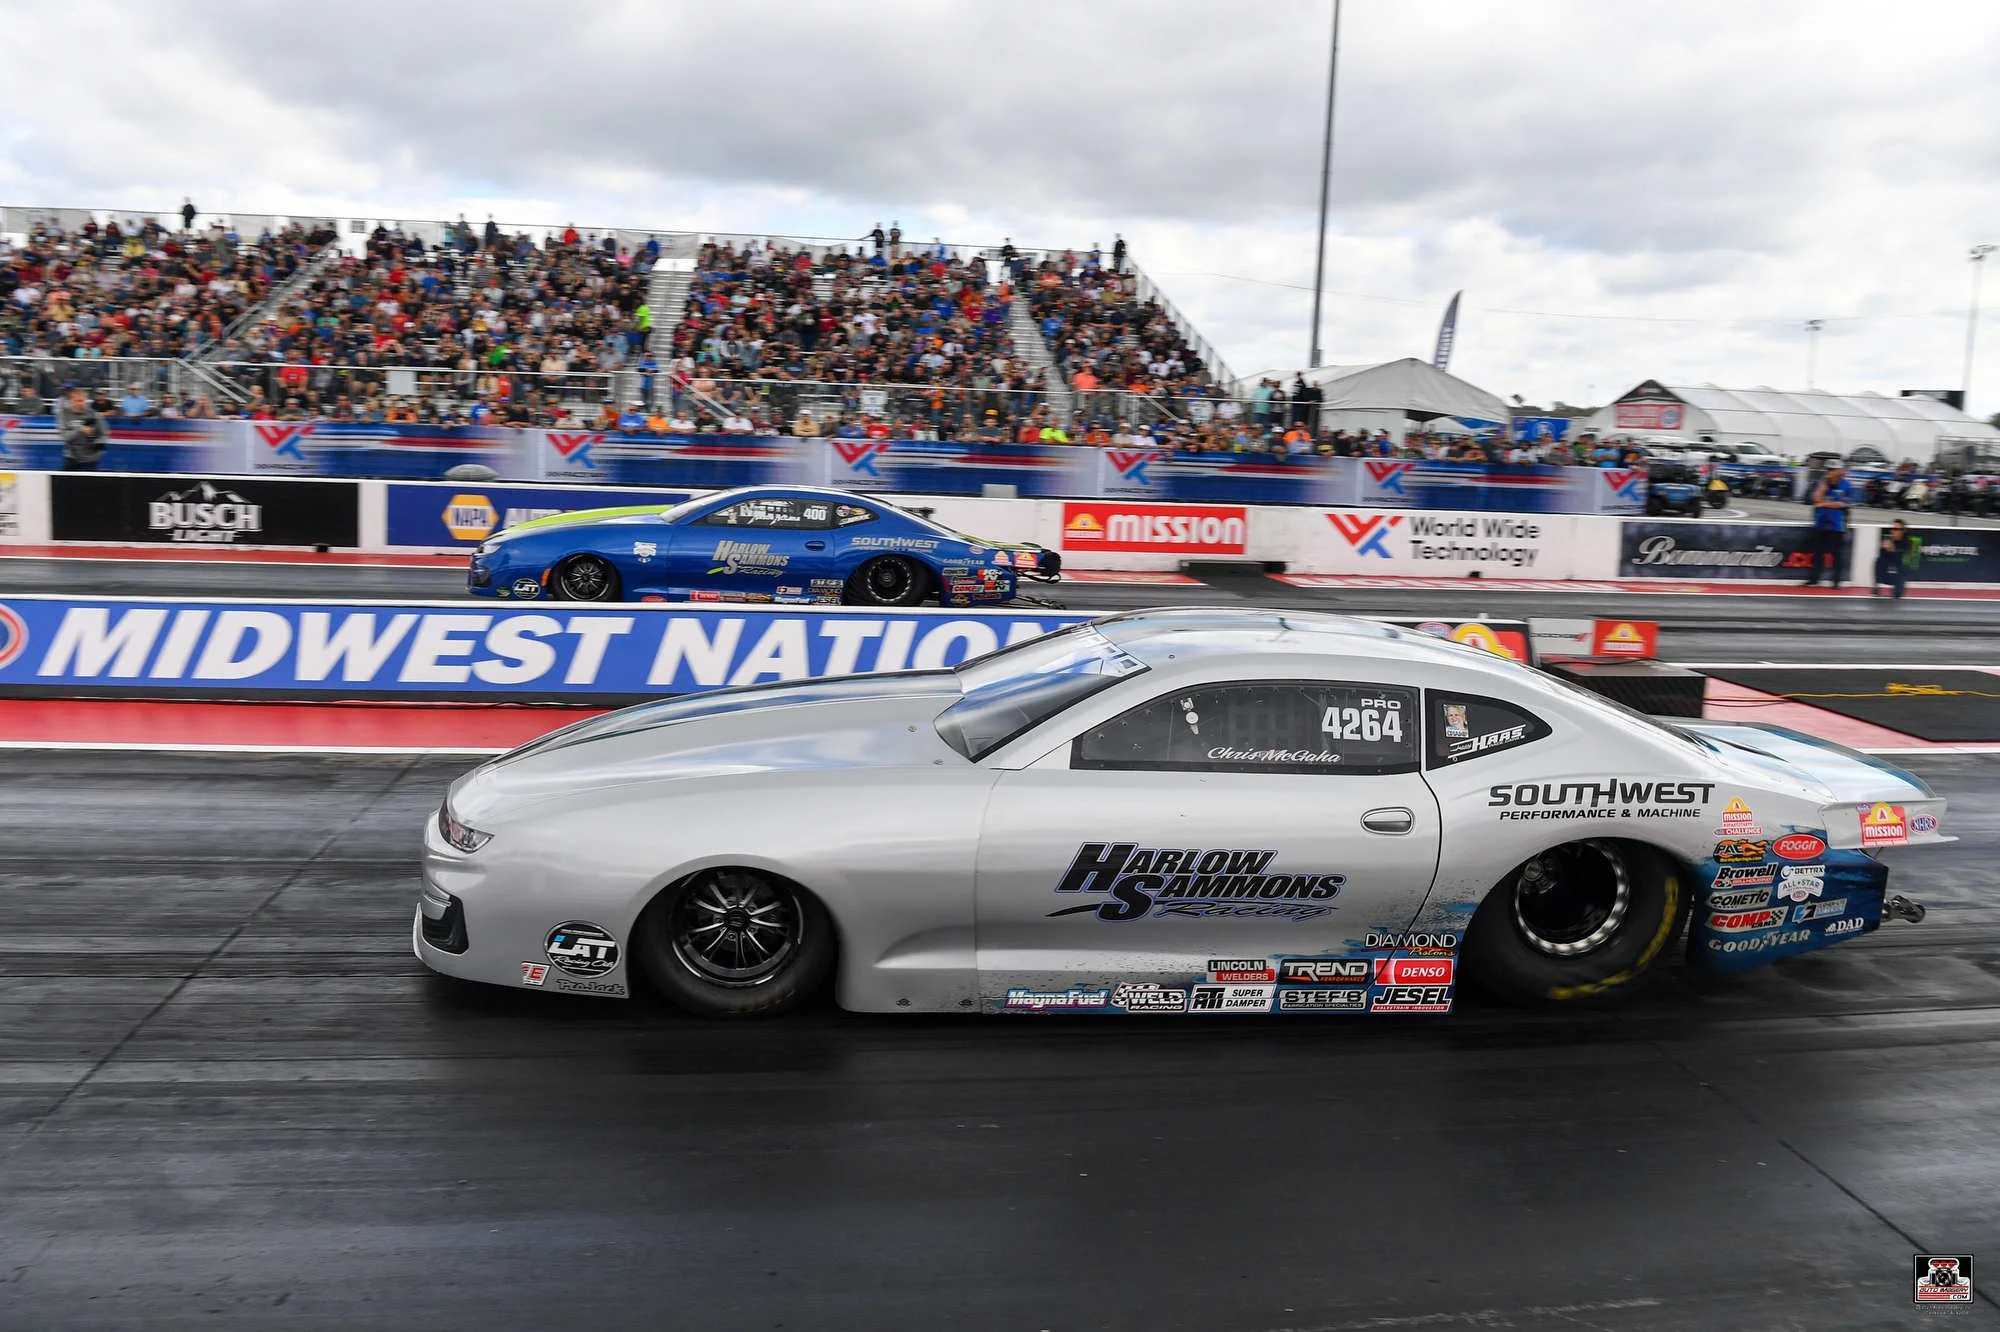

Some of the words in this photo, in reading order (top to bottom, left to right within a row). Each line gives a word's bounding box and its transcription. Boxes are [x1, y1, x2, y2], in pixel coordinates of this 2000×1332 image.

[148, 502, 262, 531] BUSCH
[803, 508, 827, 521] 400
[1106, 513, 1245, 545] MISSION
[1410, 516, 1478, 538] World
[1483, 519, 1541, 539] Wide
[713, 540, 770, 561] HARLOW
[851, 536, 940, 549] SOUTHWEST
[1410, 540, 1540, 566] Technology
[724, 554, 791, 574] SAMMONS
[37, 607, 634, 685] MIDWEST
[1361, 698, 1401, 709] PRO
[1321, 707, 1403, 743] 4264
[1207, 747, 1260, 760] Chris
[1260, 749, 1342, 763] McGaha
[1488, 778, 1715, 807] SOUTHWEST
[1500, 809, 1616, 820] PERFORMANCE
[1621, 809, 1632, 818] &
[1637, 808, 1701, 818] MACHINE
[1726, 827, 1761, 835] CHALLENGE
[1780, 841, 1818, 851] FOGGIT
[1056, 842, 1279, 893] HARLOW
[1718, 864, 1777, 879] Browell
[1096, 873, 1346, 922] SAMMONS
[1710, 890, 1770, 906] COMETIC
[1155, 902, 1330, 921] Racing
[1711, 912, 1771, 928] COMP
[1751, 920, 1777, 928] CAMS
[1838, 917, 1864, 931] DAD
[548, 935, 617, 959] LAT
[1365, 934, 1457, 948] DIAMOND
[1708, 929, 1812, 952] GOODYEAR
[1210, 960, 1264, 971] LINCOLN
[1283, 962, 1369, 981] TREND
[1401, 967, 1446, 977] DENSO
[1222, 972, 1269, 982] WELDERS
[1007, 990, 1106, 1008] MagnaFuel
[1128, 992, 1184, 1004] WELD
[1231, 988, 1264, 998] SUPER
[1374, 988, 1452, 1005] JESEL
[1225, 998, 1266, 1008] DAMPER
